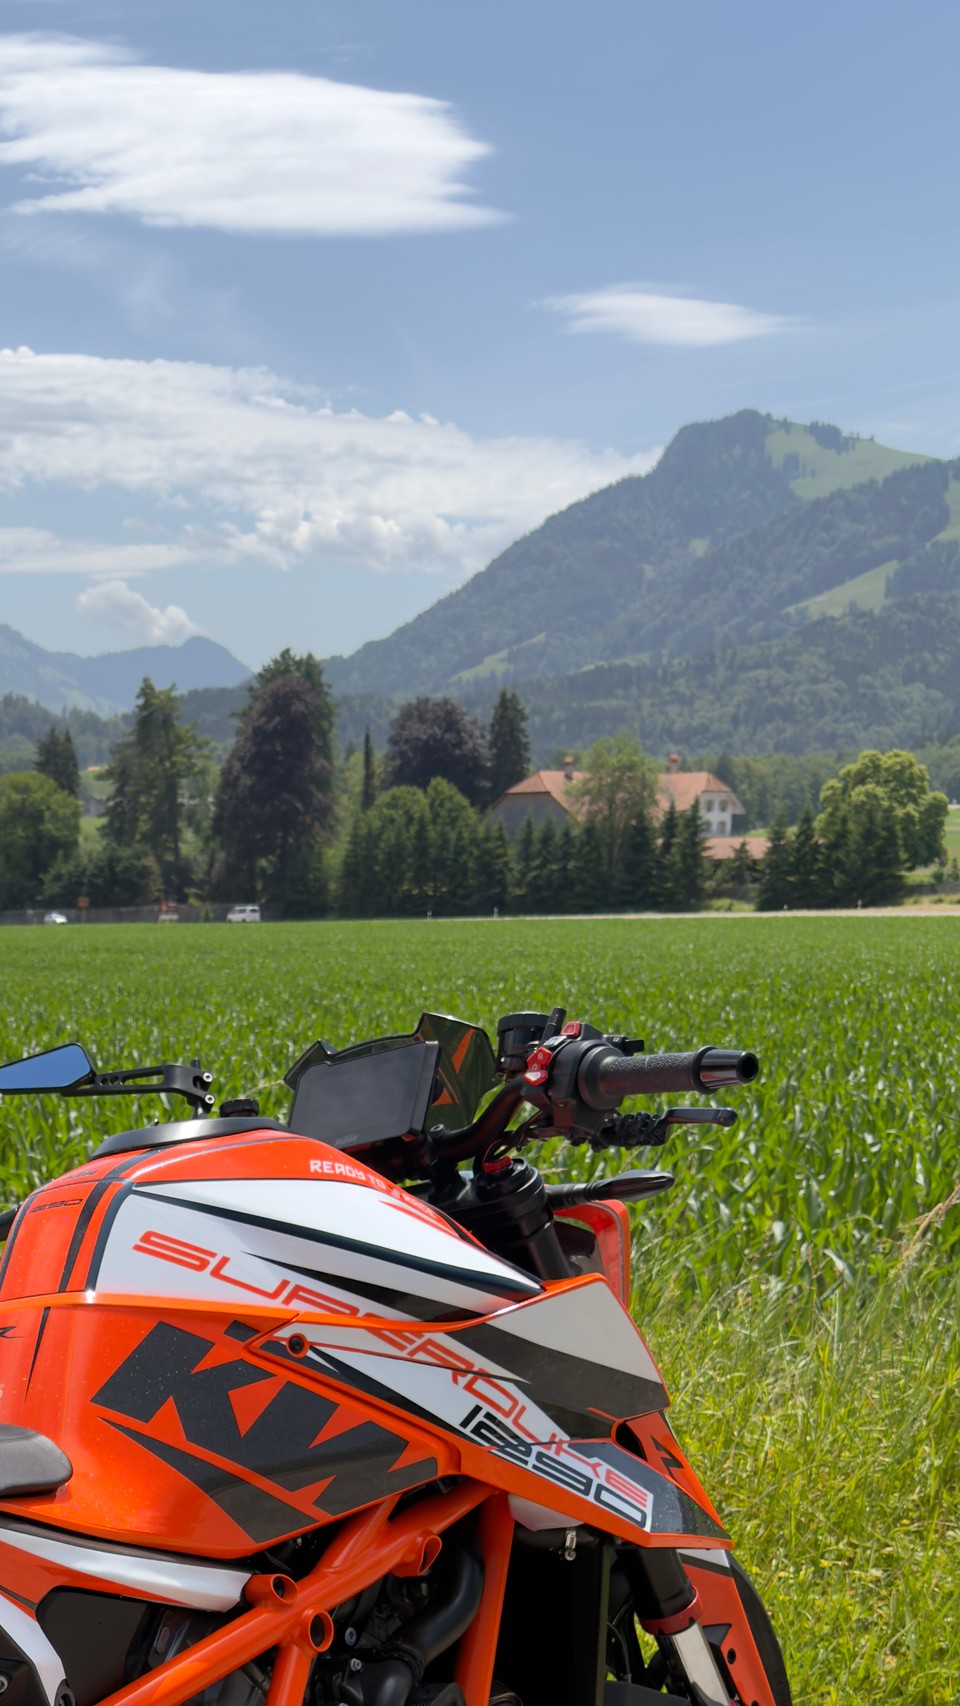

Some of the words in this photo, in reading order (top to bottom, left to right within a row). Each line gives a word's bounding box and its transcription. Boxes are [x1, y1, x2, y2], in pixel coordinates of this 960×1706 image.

[309, 1159, 366, 1181] READY
[366, 1173, 387, 1190] TO
[90, 1320, 438, 1517] KTM
[459, 1404, 647, 1529] 1290
